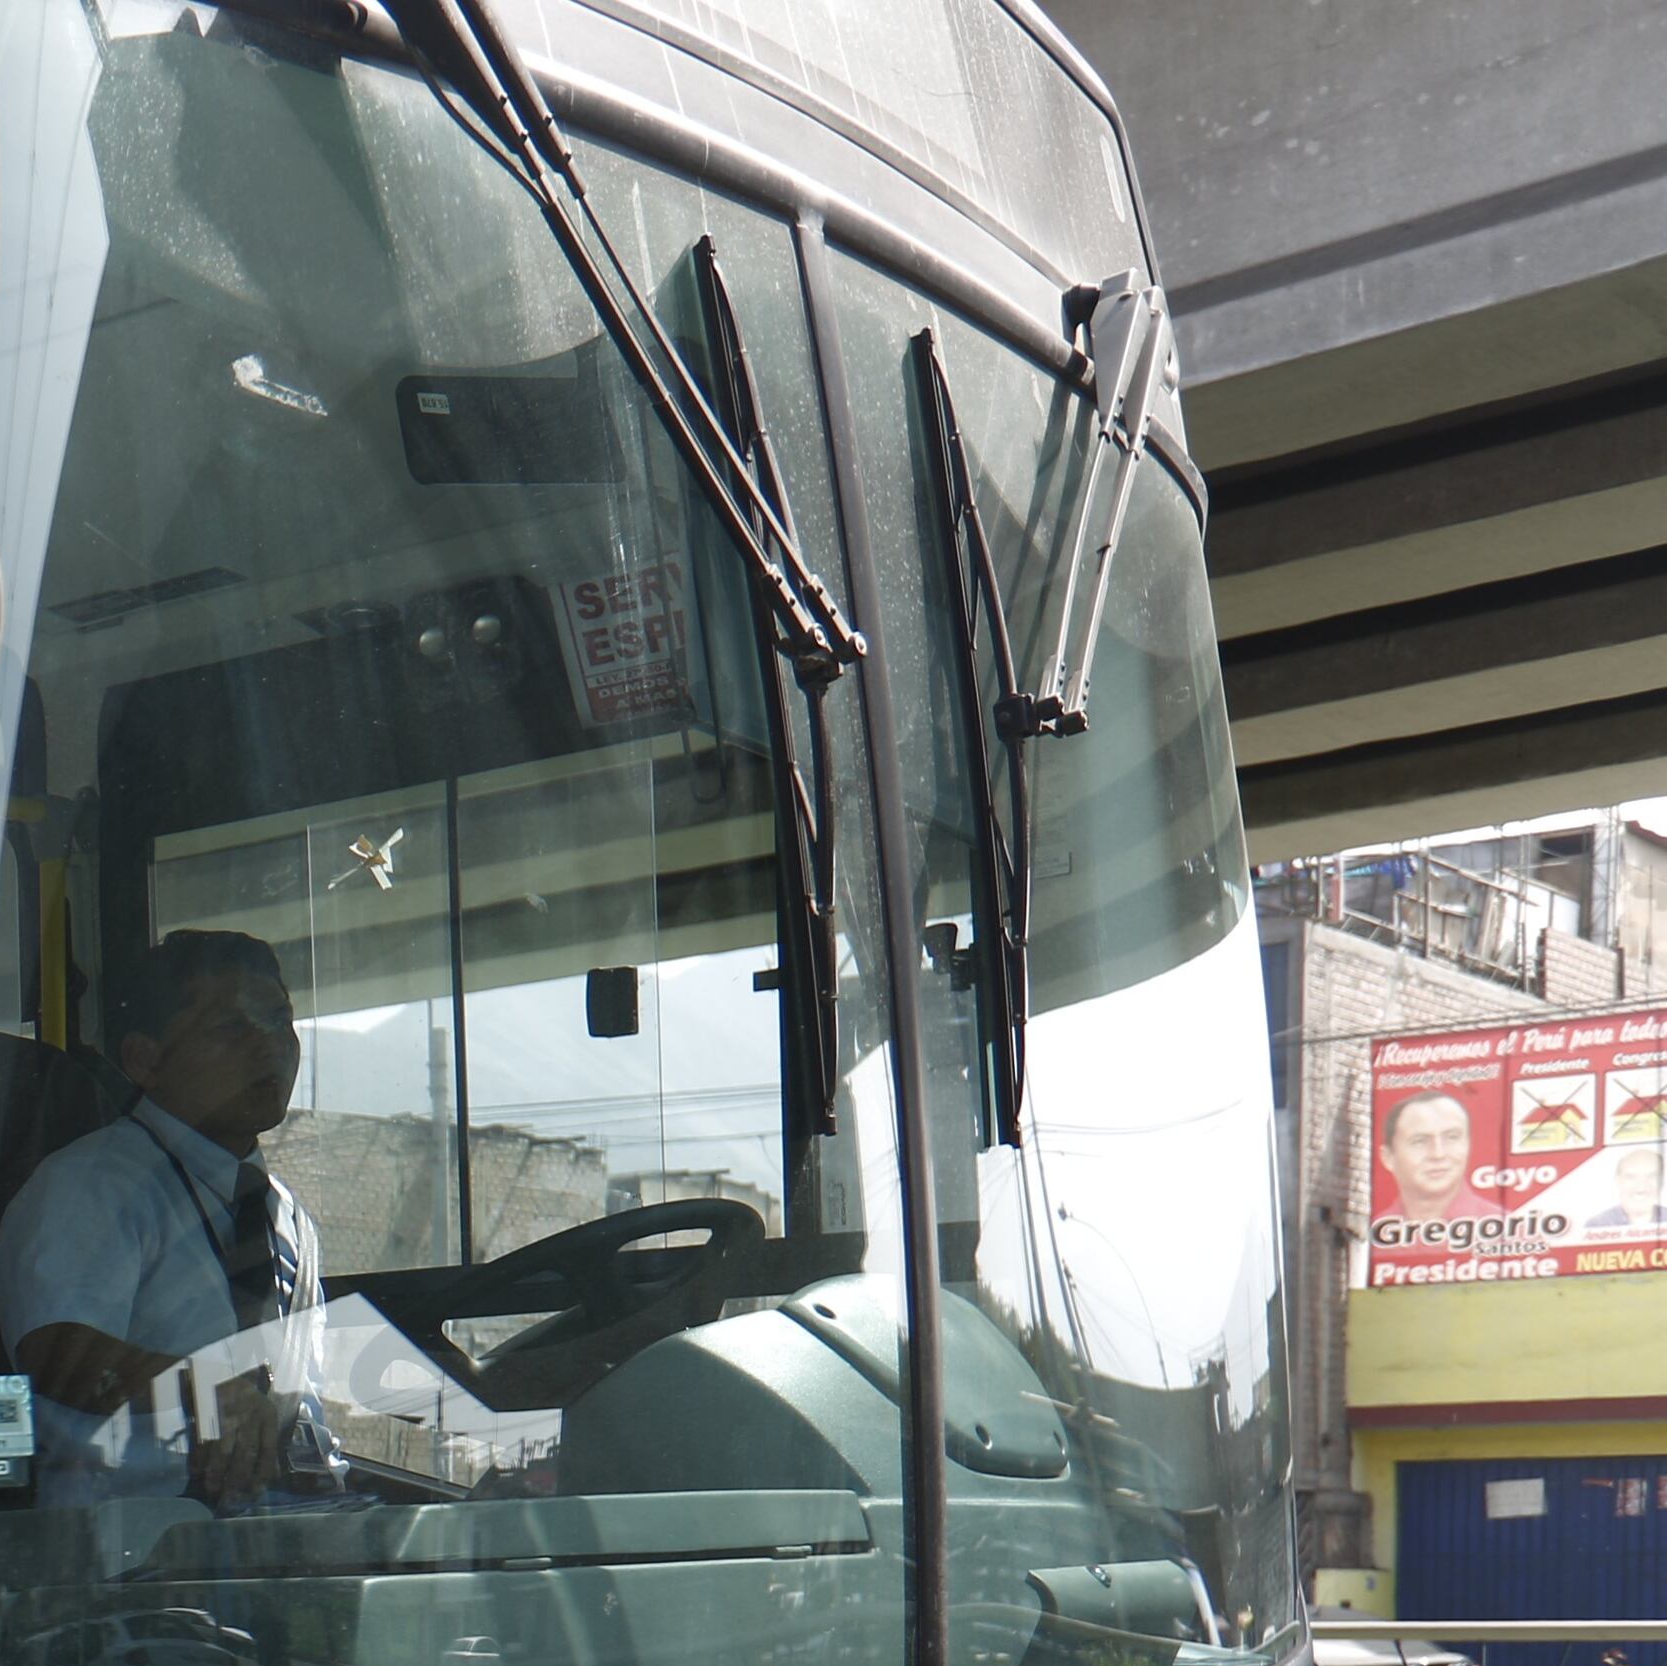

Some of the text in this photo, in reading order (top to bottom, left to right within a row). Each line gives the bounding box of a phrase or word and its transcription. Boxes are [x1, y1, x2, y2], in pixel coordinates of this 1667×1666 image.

[1497, 1034, 1517, 1056] el
[1570, 1026, 1614, 1053] para
[1520, 1057, 1590, 1075] Presidente
[1471, 1165, 1558, 1191] Goyo
[1371, 1210, 1567, 1251] Gregorio
[1476, 1240, 1547, 1256] Santos
[1576, 1249, 1645, 1272] NUEVA
[1373, 1256, 1559, 1285] Presidente
